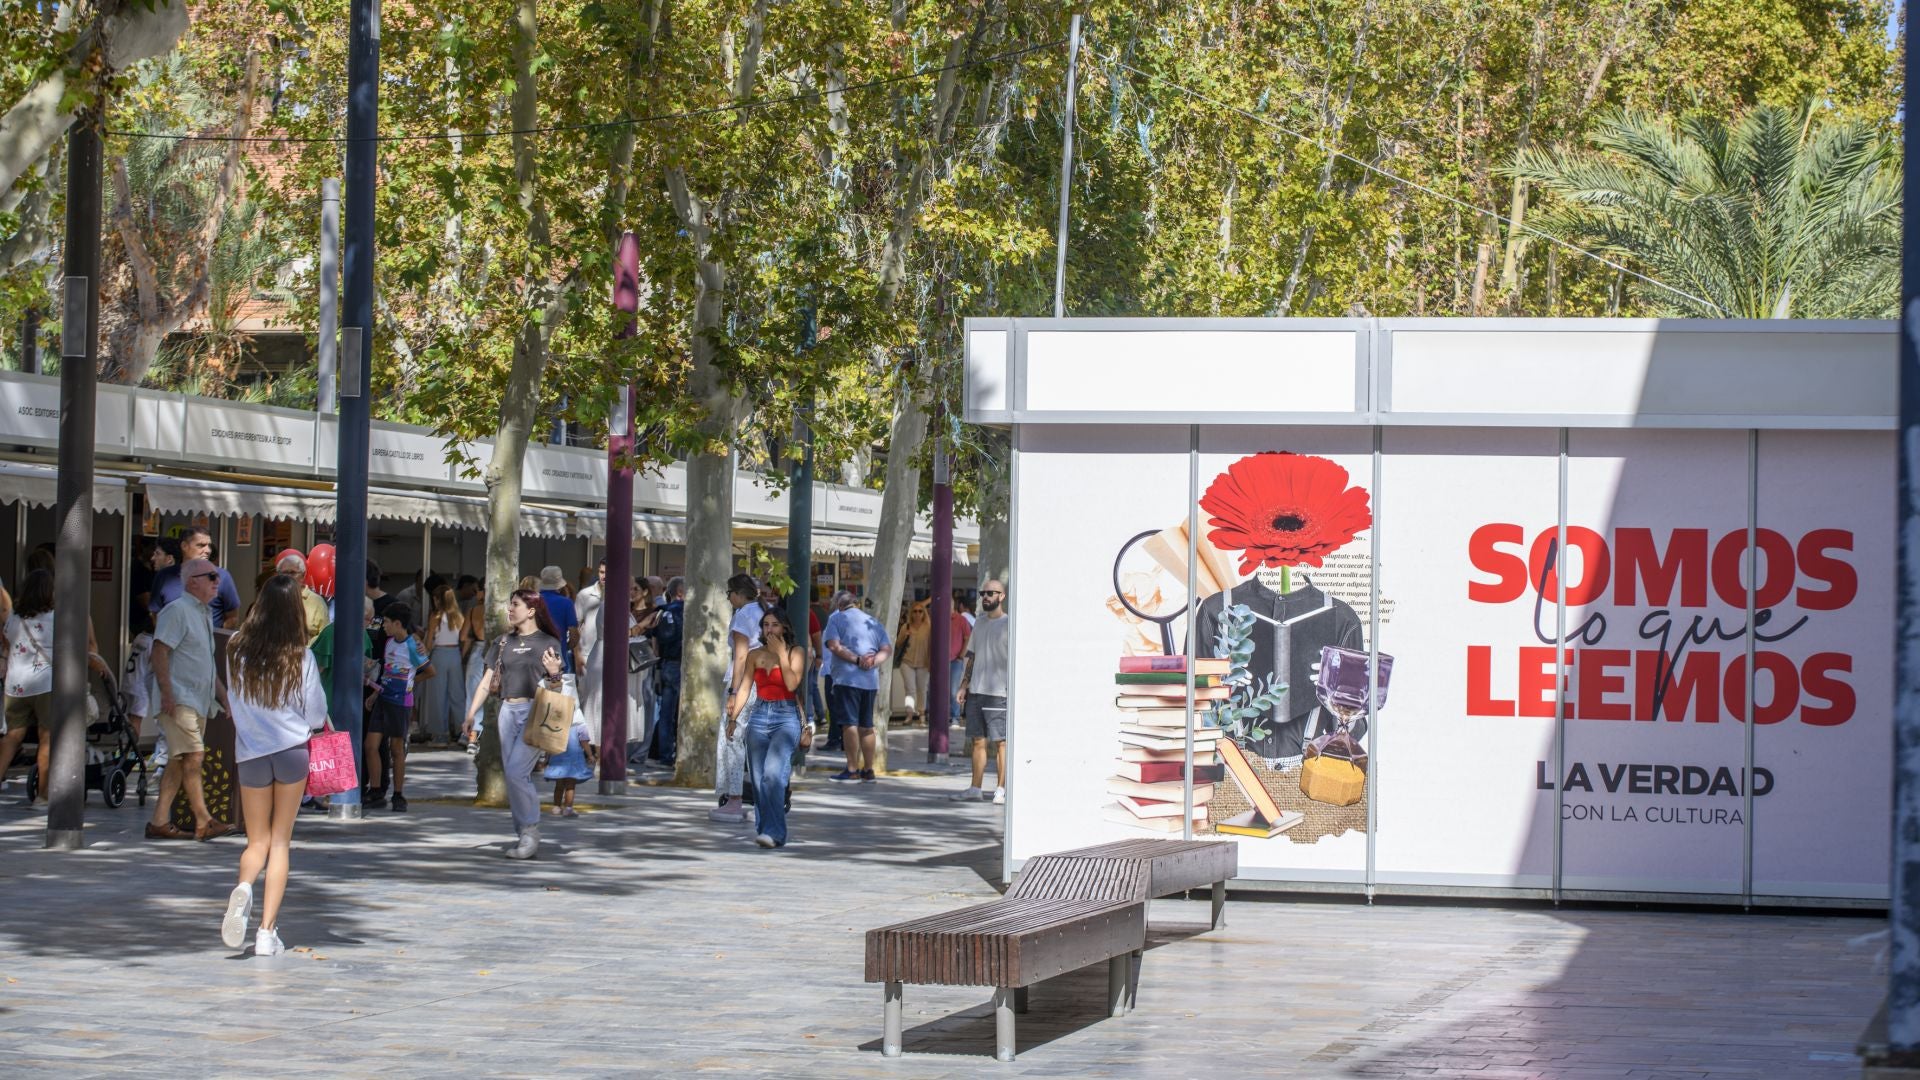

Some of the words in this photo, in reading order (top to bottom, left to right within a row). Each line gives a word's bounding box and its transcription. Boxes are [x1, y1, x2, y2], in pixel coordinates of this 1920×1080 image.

[1468, 522, 1858, 611] SOMOS
[1534, 537, 1607, 645] lo
[1638, 608, 1808, 721] que
[1466, 645, 1857, 726] LEEMOS
[308, 758, 335, 772] RUNI
[1536, 760, 1594, 792] LA
[1598, 764, 1774, 796] VERDAD
[1560, 804, 1604, 821] CON
[1612, 805, 1638, 822] LA
[1645, 806, 1744, 825] CULTURA
